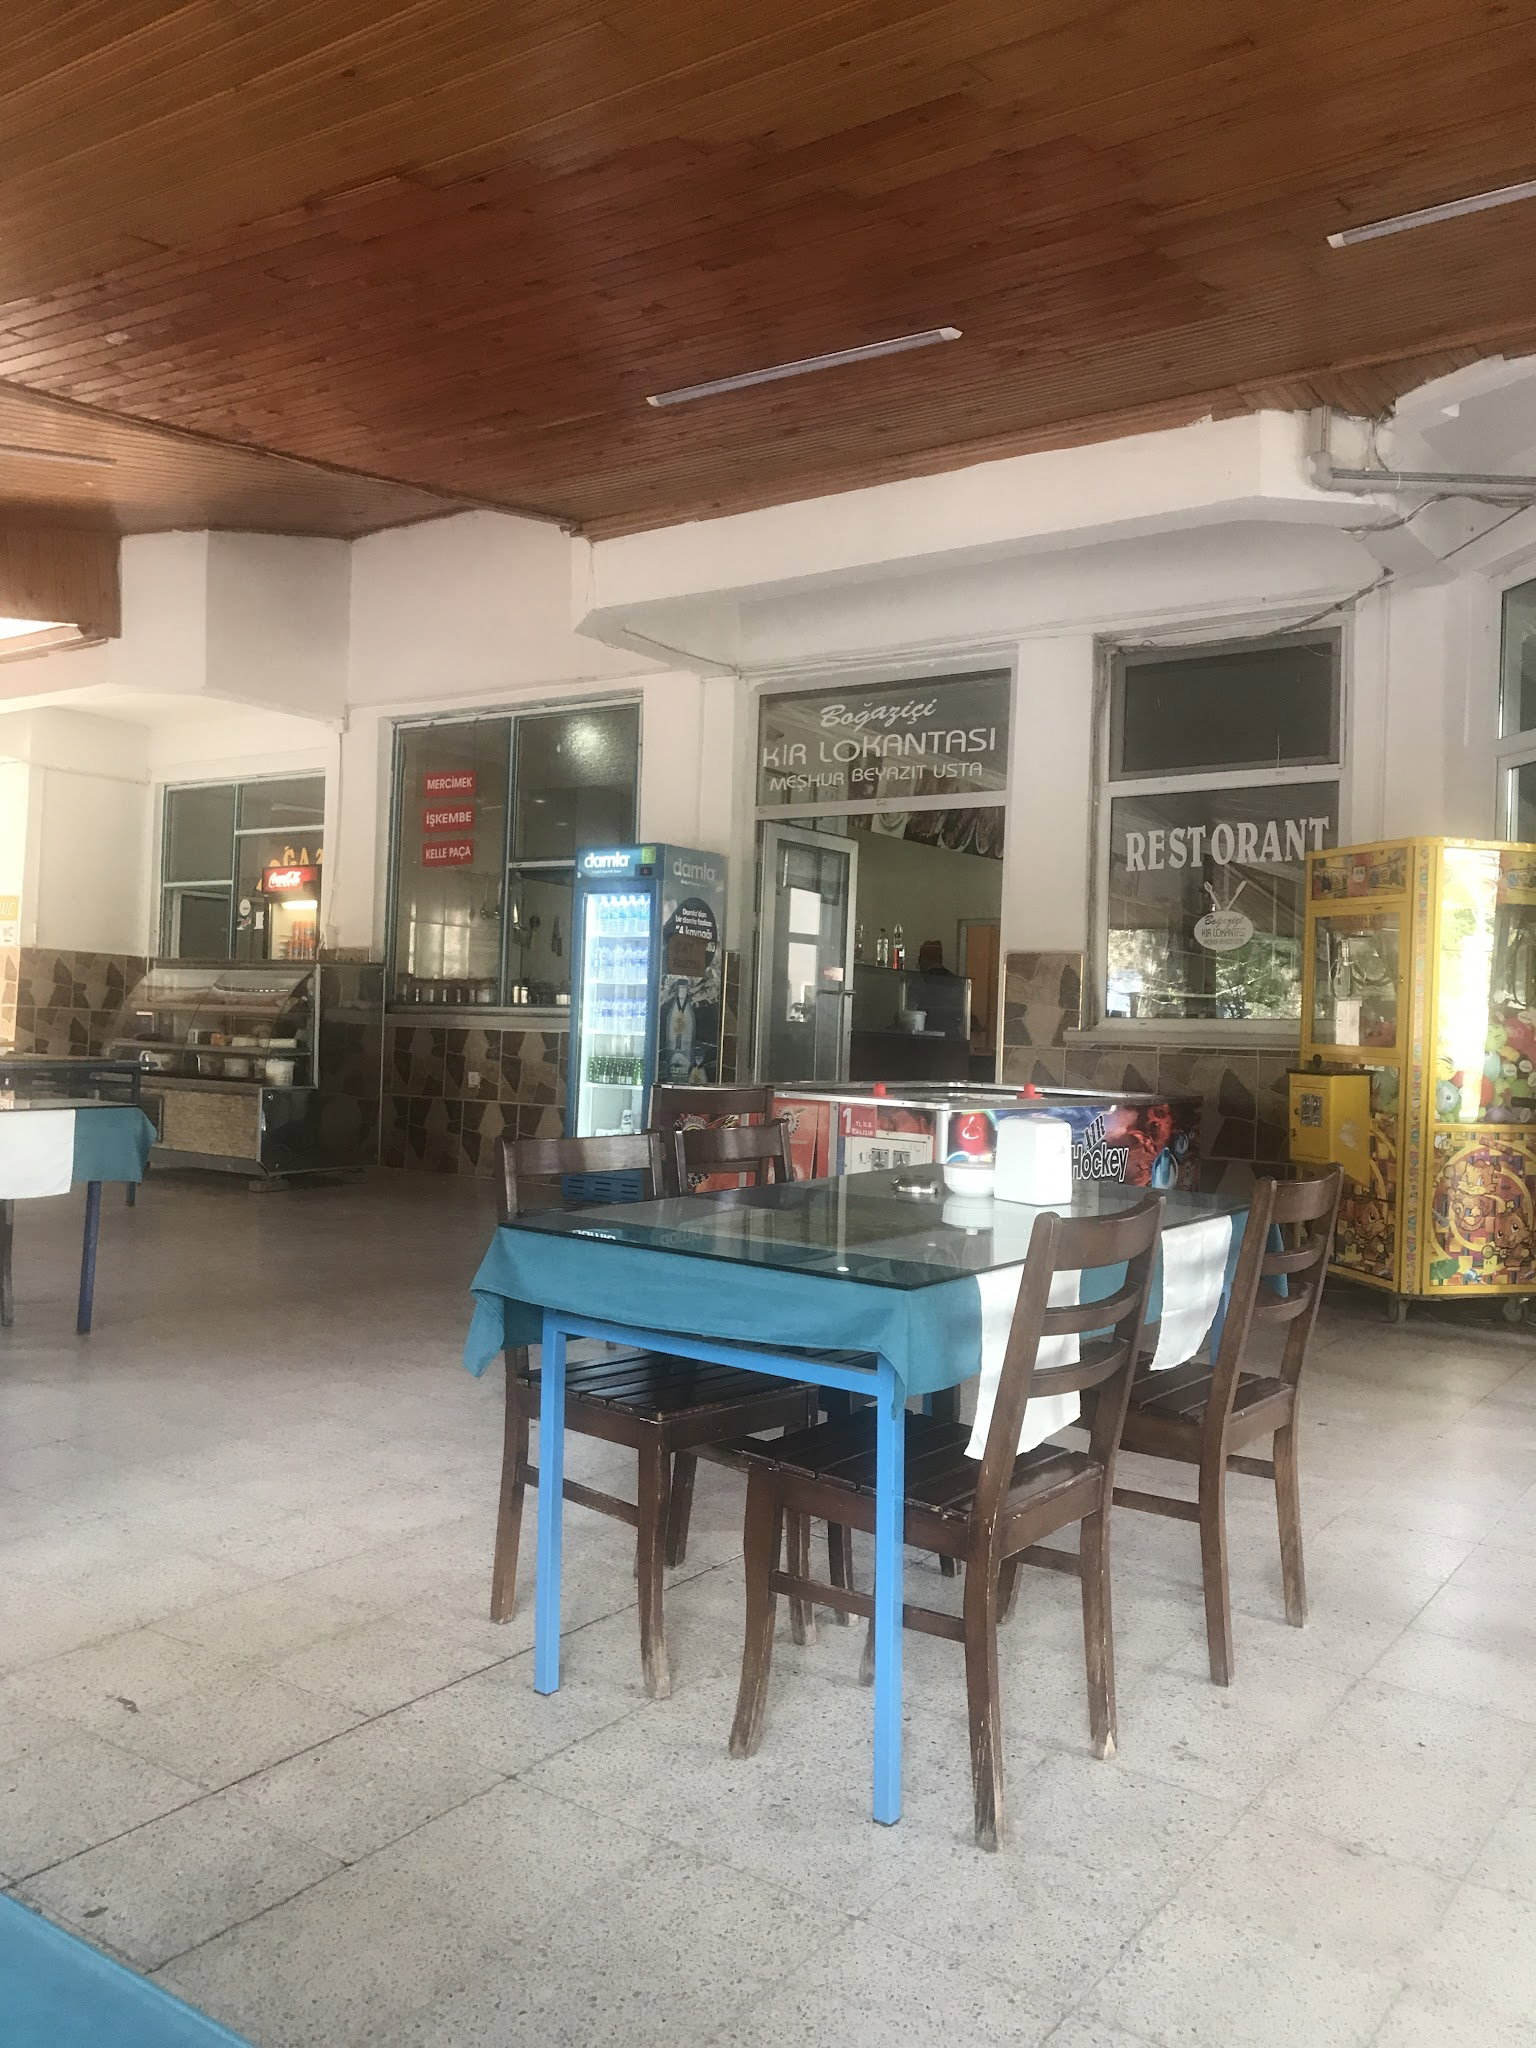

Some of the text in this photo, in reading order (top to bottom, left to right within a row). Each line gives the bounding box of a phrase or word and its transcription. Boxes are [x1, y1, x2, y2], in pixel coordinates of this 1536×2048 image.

[820, 698, 938, 731] Boğaziçi
[762, 727, 996, 767] KIR LOKANTASI
[426, 776, 473, 790] MERCİMEK
[769, 762, 983, 791] MEŞHUR BEYAZIT USTA
[426, 811, 472, 828] İŞKEMBE
[425, 846, 472, 860] KELLE PAÇA
[584, 851, 631, 869] damla
[672, 857, 716, 881] damla
[842, 1107, 852, 1134] 1
[1071, 1142, 1130, 1183] Hockey
